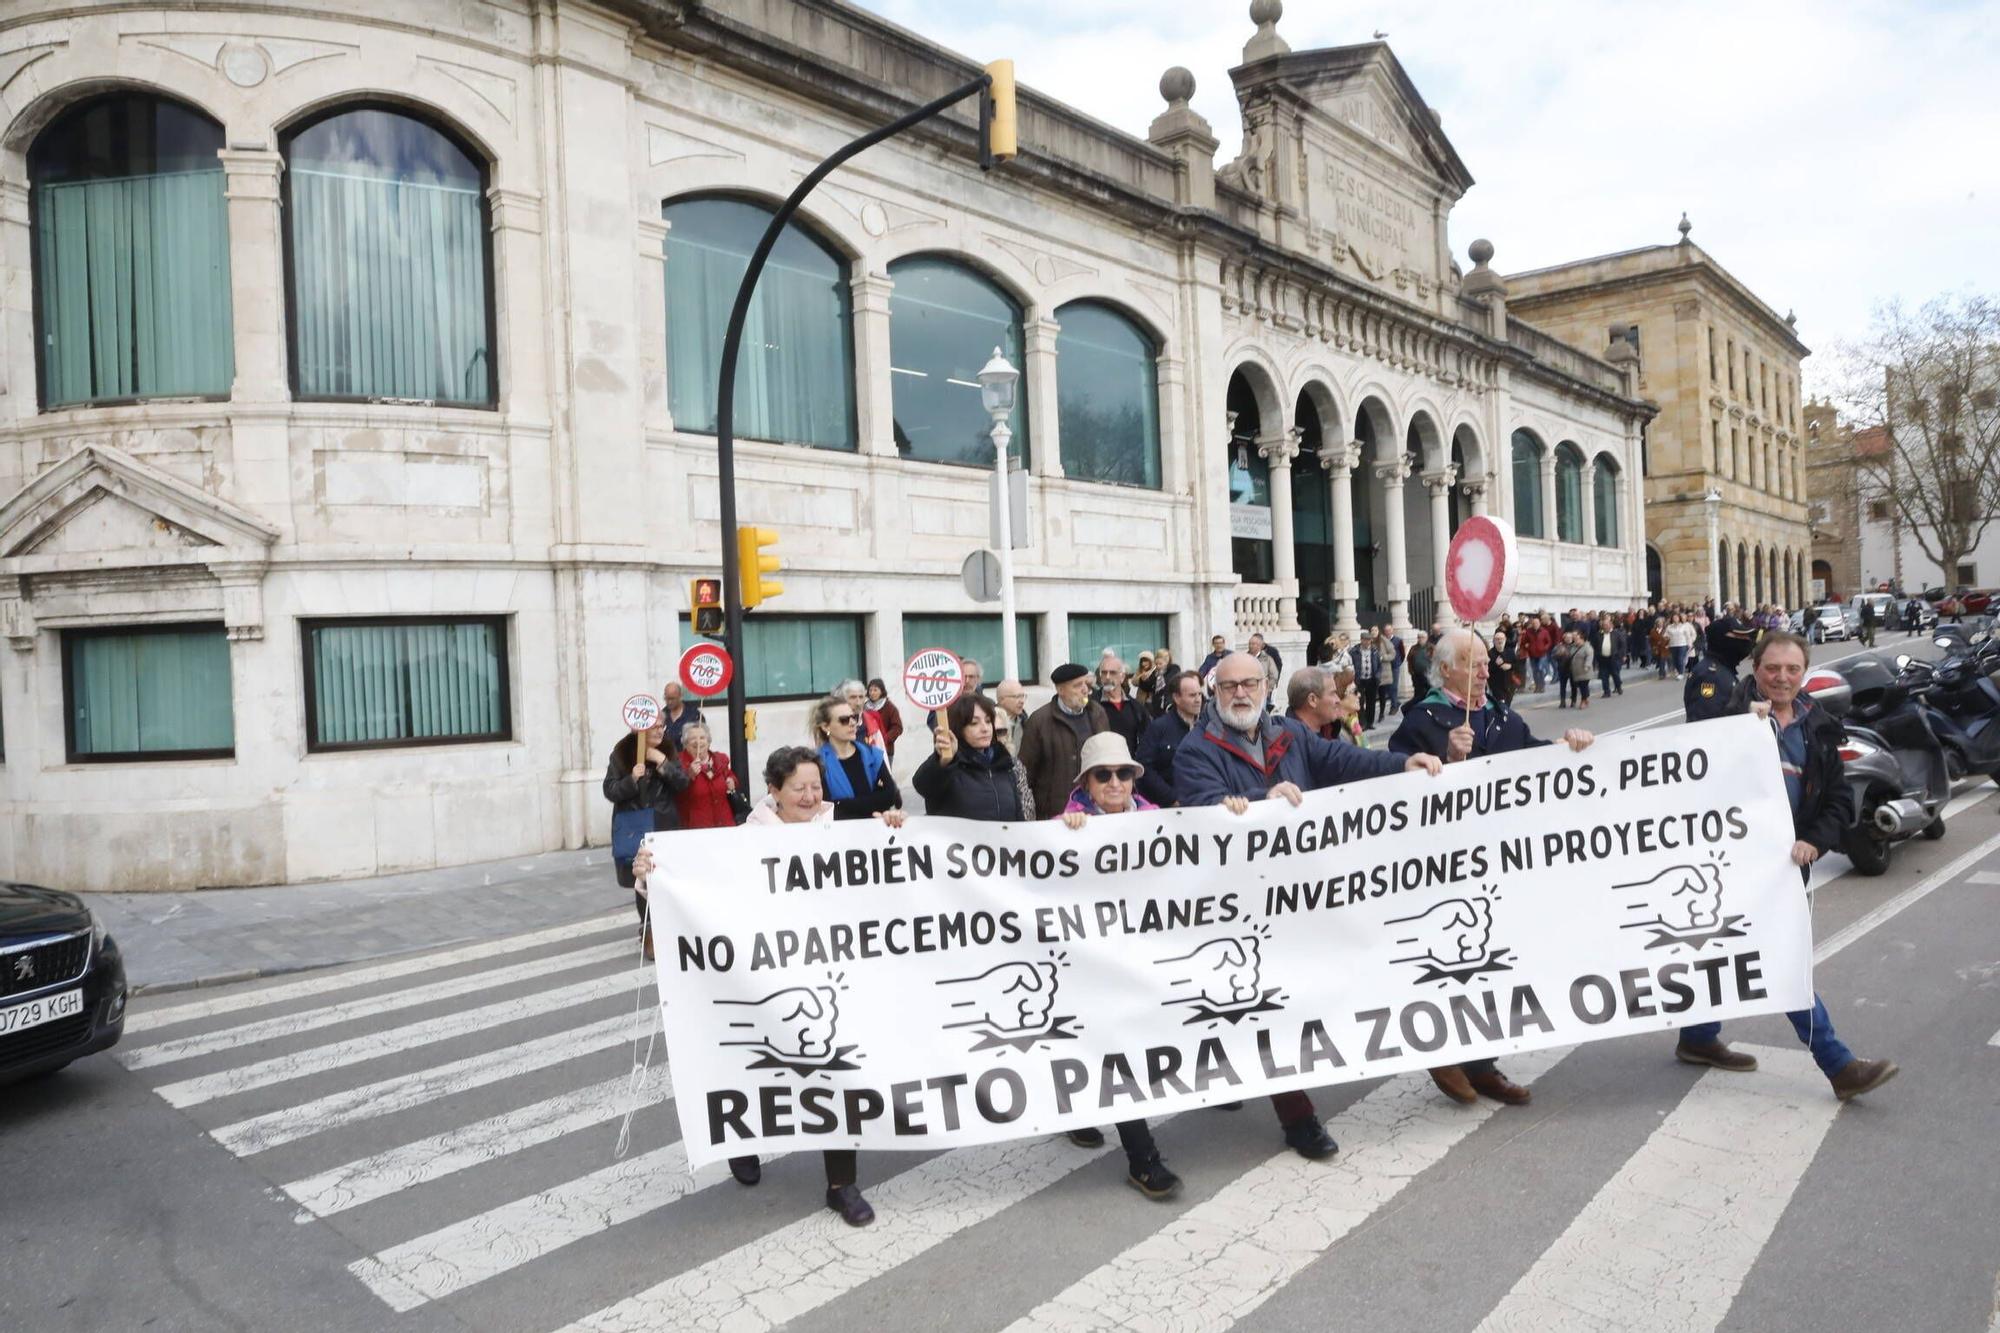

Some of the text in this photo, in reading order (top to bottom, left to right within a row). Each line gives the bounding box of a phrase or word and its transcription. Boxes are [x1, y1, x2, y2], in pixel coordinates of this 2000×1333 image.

[1335, 197, 1408, 253] MUNICIPAL
[920, 691, 953, 705] JOVE
[761, 747, 1709, 894] TAMBIÉN SOMOS GIJÓN Y PAGAMOS IMPUESTOS, PERO
[677, 806, 1748, 973] NO APARECEMOS EN PLANES, INVERSIONES NI PROYECTOS
[48, 993, 78, 1018] KGH
[706, 949, 1769, 1146] RESPETO PARA LA ZONA OESTE
